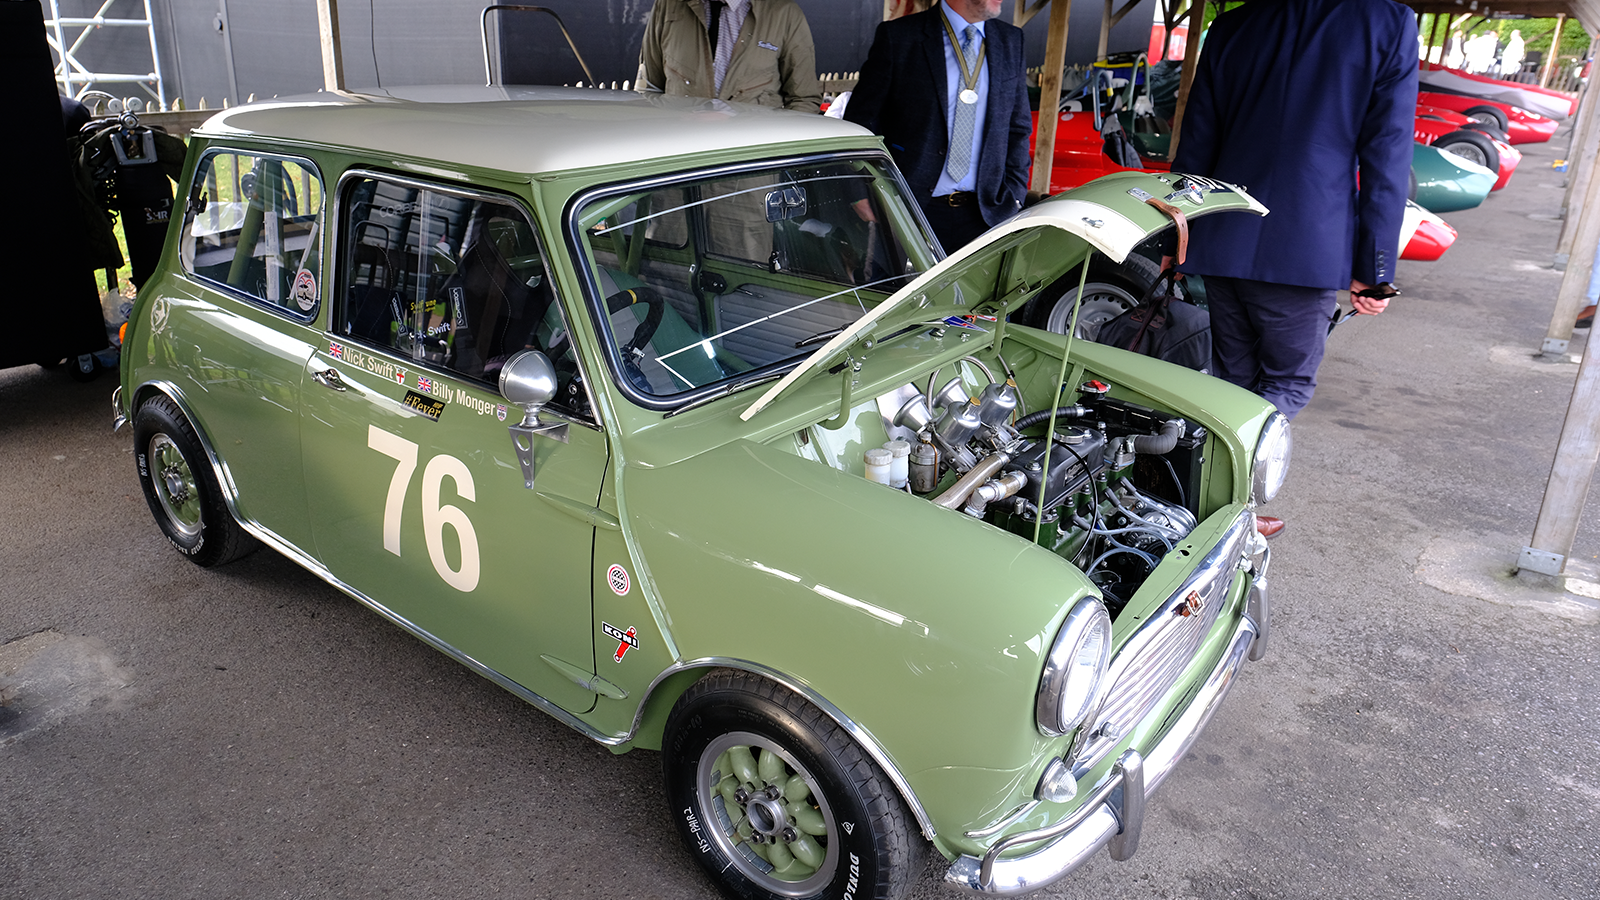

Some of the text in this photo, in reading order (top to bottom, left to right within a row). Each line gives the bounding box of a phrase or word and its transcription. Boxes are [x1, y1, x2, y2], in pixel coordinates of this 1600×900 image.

[427, 322, 451, 336] Swift
[343, 347, 394, 379] Nick Swift
[404, 394, 442, 419] #Fever
[432, 380, 495, 415] Billy Monger
[368, 424, 480, 592] 76
[604, 625, 637, 646] KONI
[842, 852, 860, 900] DUNLO
